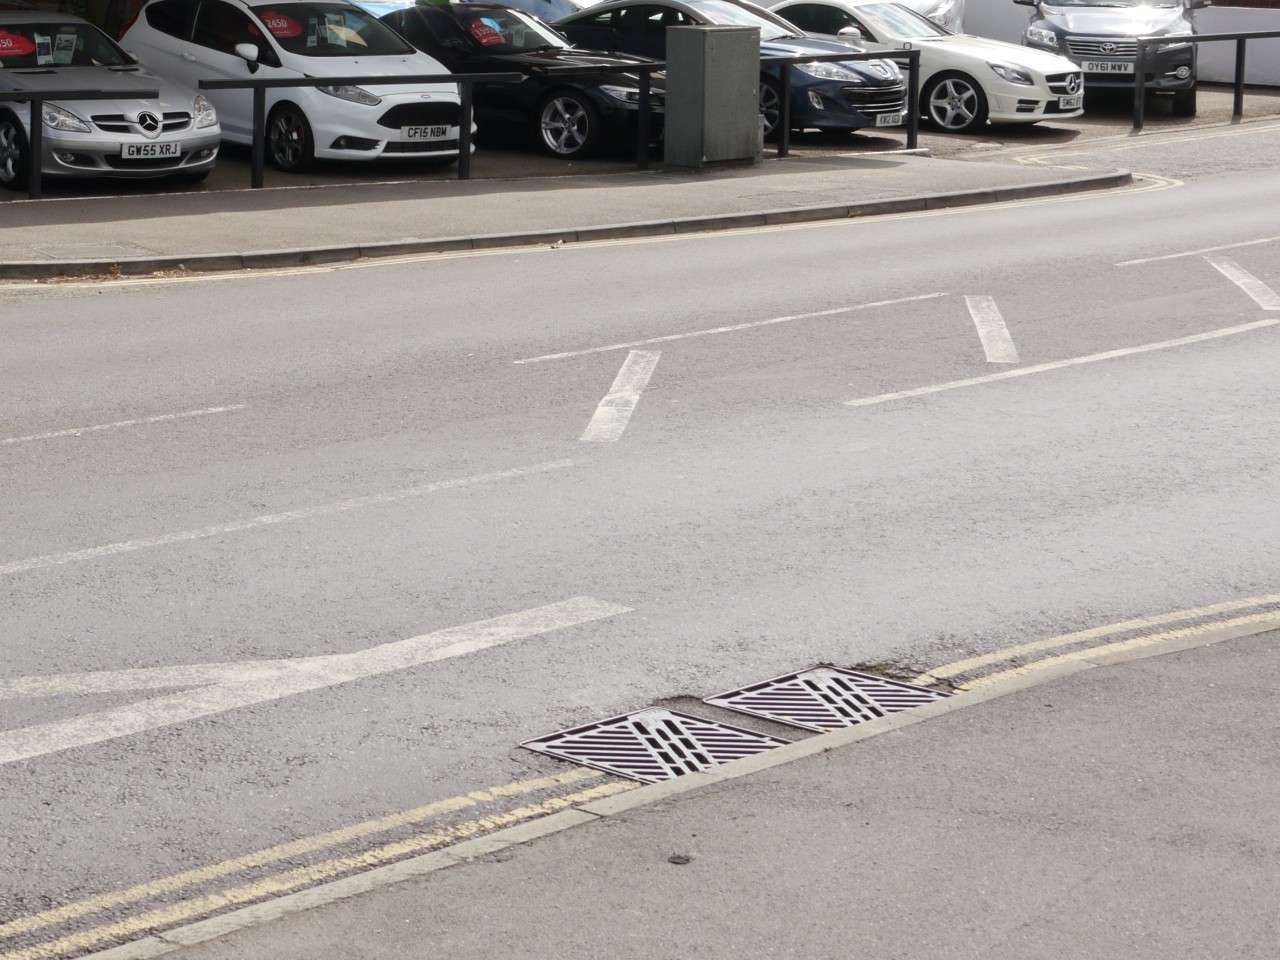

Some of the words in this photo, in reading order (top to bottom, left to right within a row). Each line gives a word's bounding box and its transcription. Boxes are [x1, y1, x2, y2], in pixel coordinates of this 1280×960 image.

[1087, 62, 1109, 72] OY61
[407, 127, 429, 138] CF15
[128, 145, 156, 156] GW55
[159, 143, 178, 155] XRJ
